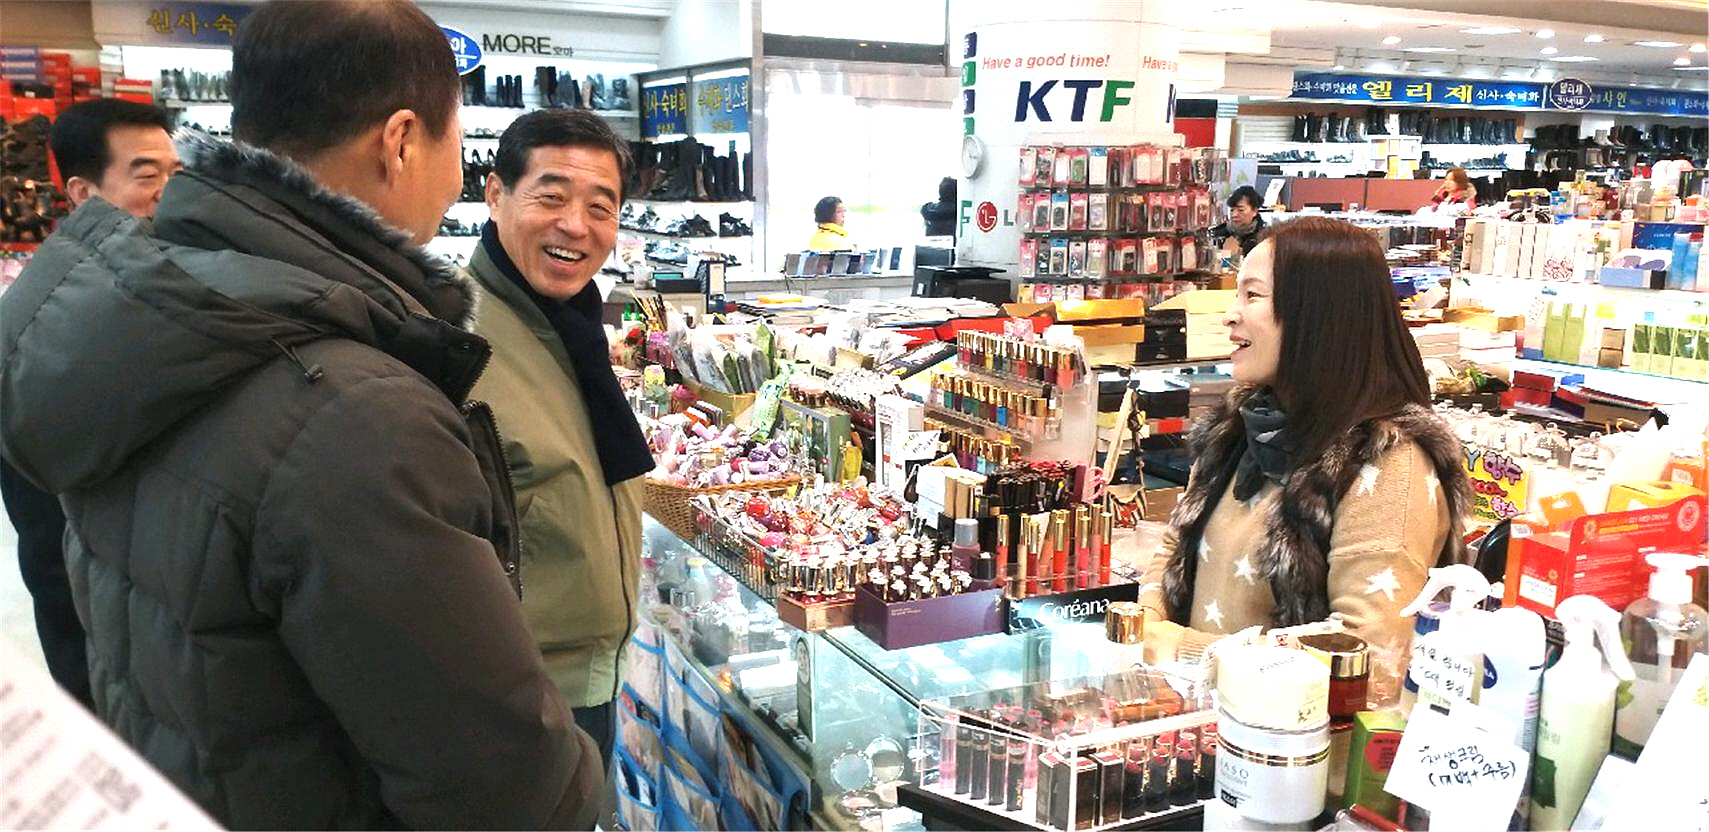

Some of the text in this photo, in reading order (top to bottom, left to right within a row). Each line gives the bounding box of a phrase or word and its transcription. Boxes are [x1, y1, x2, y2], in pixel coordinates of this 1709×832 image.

[482, 33, 552, 56] MORE
[982, 53, 1111, 70] Have a good time!
[1014, 80, 1135, 122] KTF
[1039, 598, 1109, 623] Coréana
